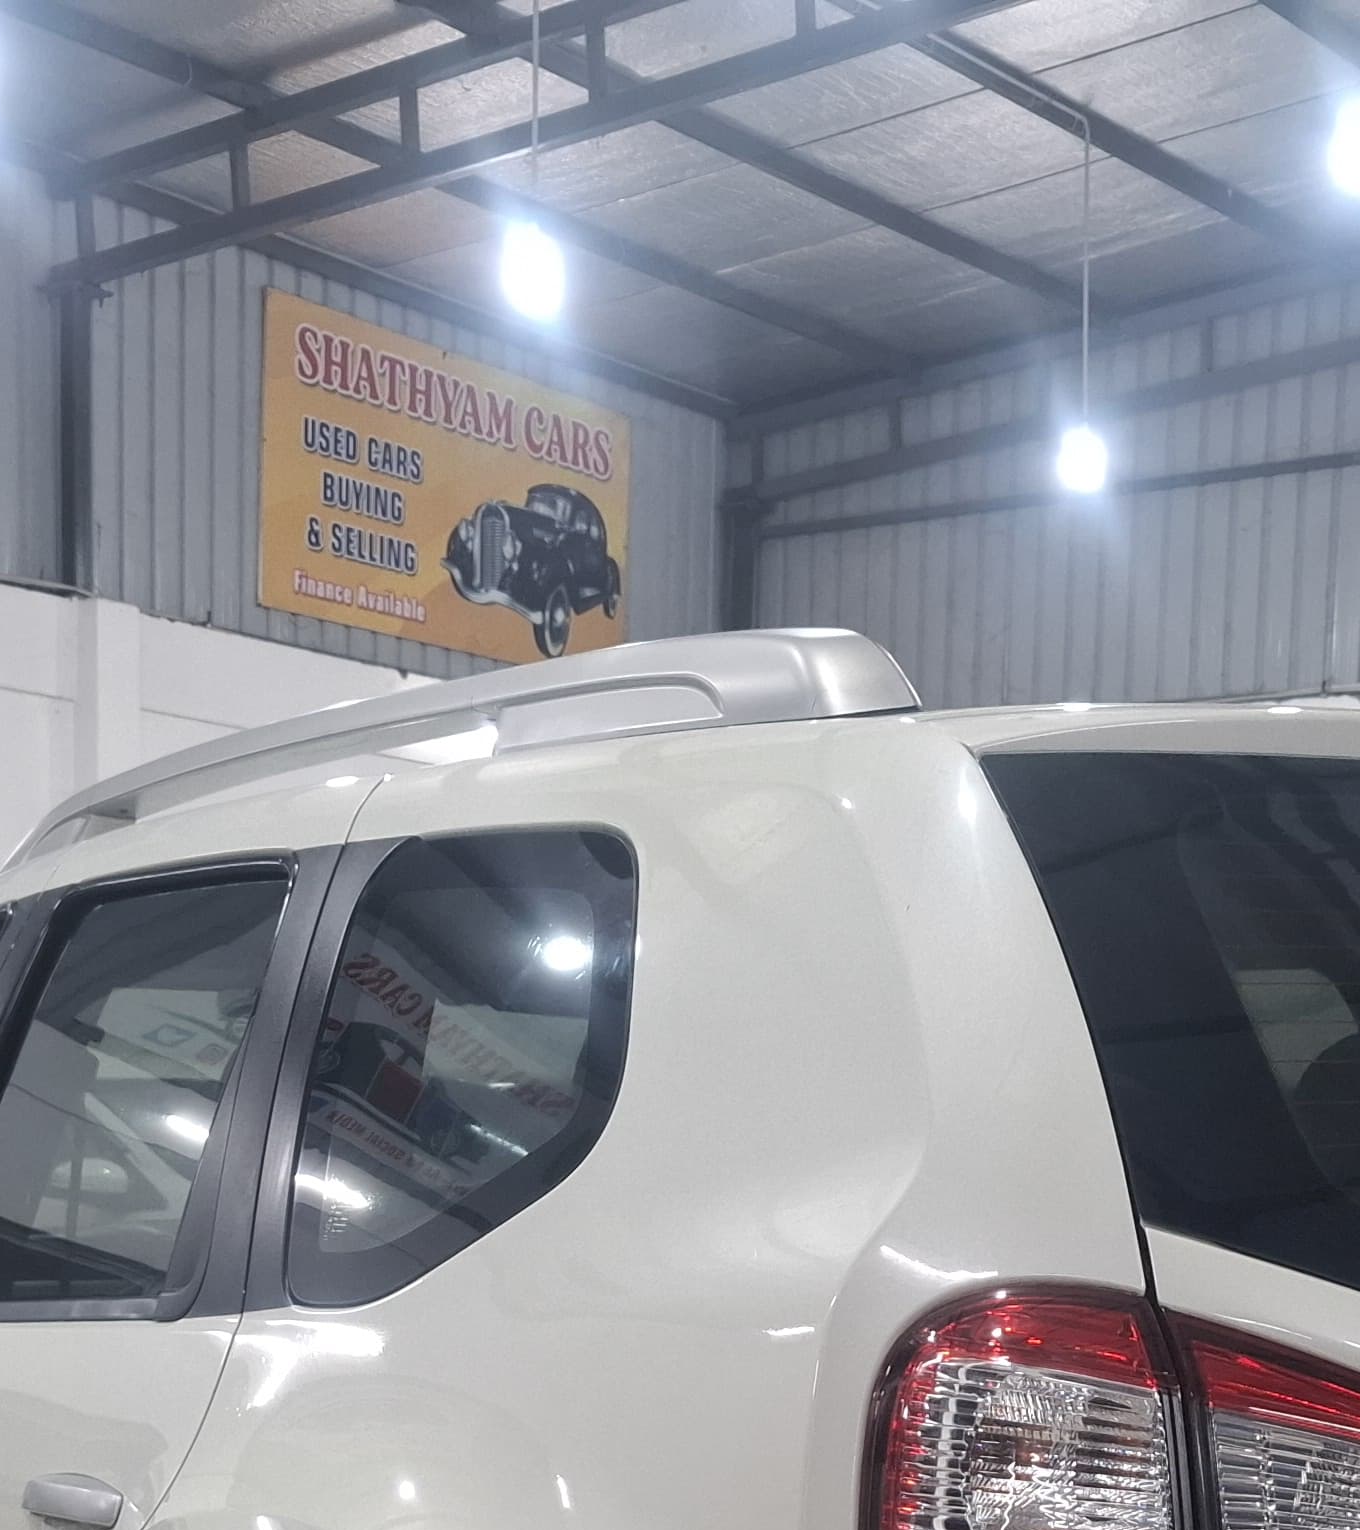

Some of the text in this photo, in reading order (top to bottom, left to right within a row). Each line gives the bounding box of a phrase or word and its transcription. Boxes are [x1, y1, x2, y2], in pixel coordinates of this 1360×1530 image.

[296, 323, 612, 479] SHATHYAM CARS
[303, 416, 422, 482] USED CARS
[322, 471, 404, 523] BUYING
[307, 516, 417, 574] & SELLING
[293, 569, 426, 622] Finance Available
